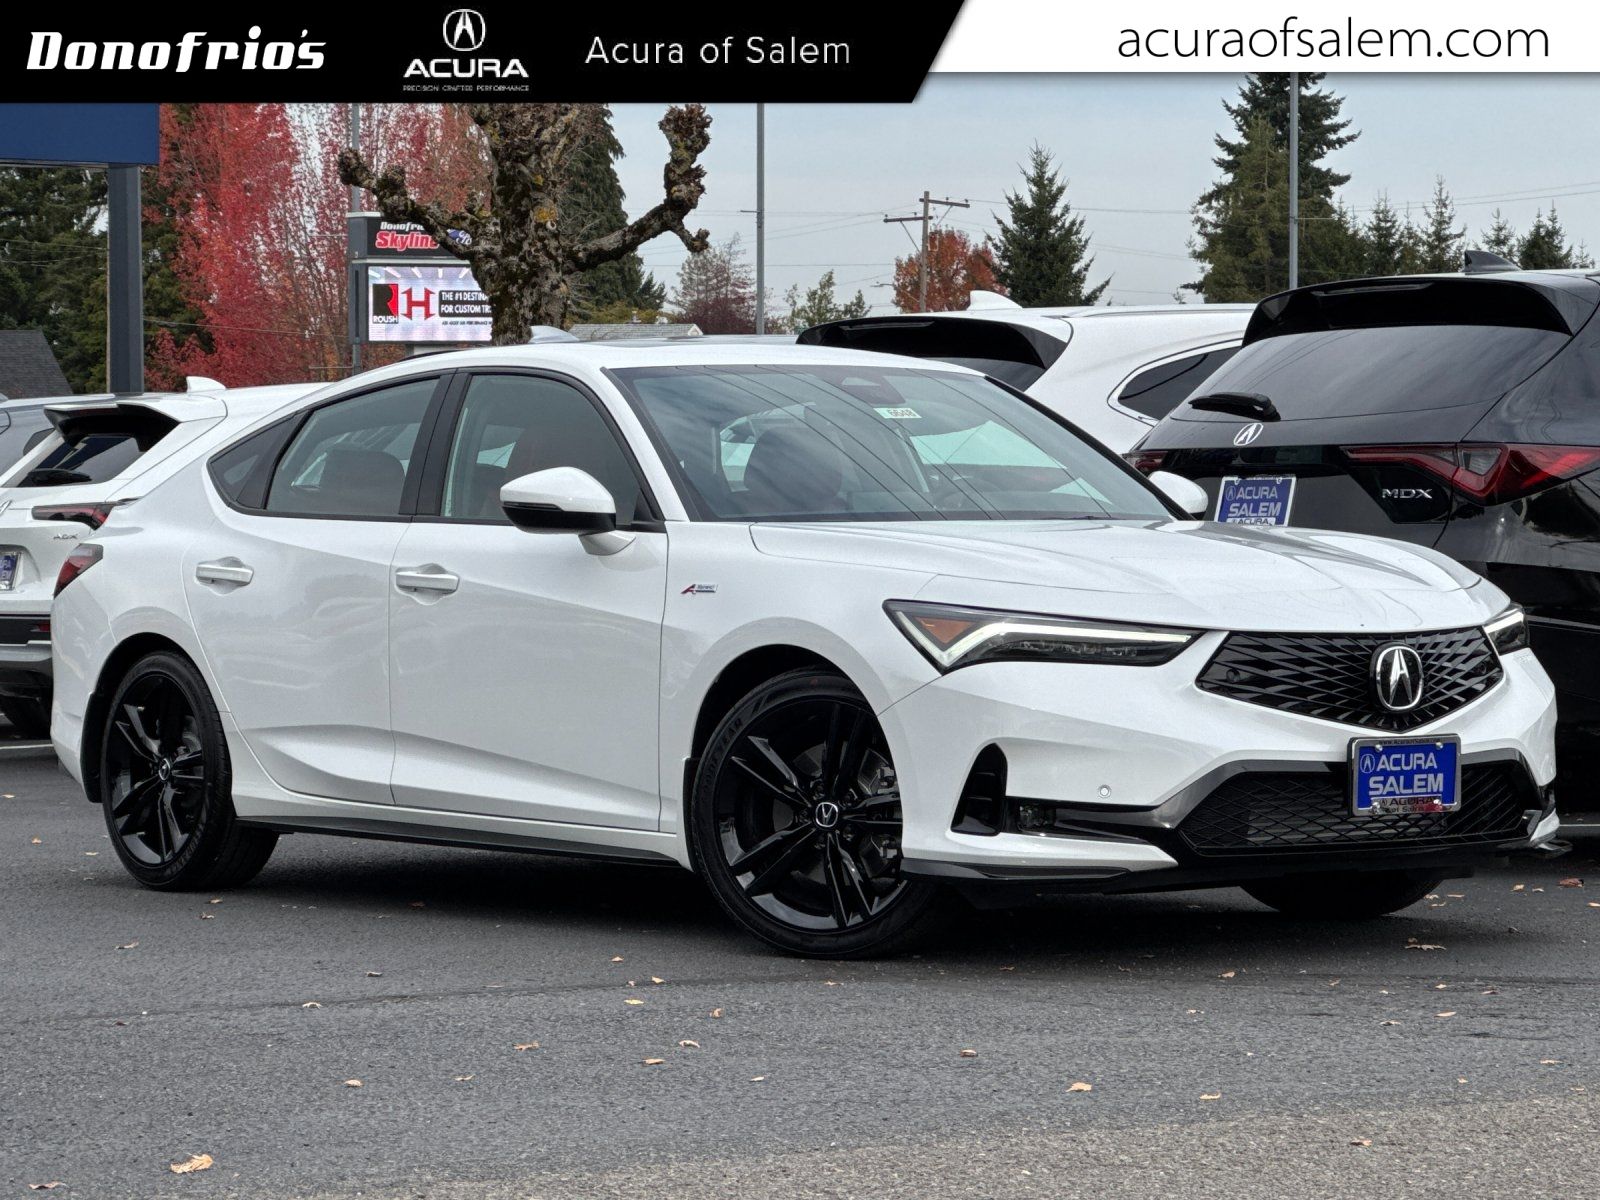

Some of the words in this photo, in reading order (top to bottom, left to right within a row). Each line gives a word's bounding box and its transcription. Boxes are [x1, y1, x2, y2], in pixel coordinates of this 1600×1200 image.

[441, 291, 454, 301] THE
[455, 291, 463, 301] #1
[440, 304, 454, 313] FOR
[454, 304, 481, 314] CUSTOM
[372, 315, 399, 323] ROUSH
[1235, 485, 1279, 500] ACURA
[1381, 488, 1433, 499] MDX
[1227, 501, 1282, 518] SALEM
[1376, 752, 1438, 772] ACURA
[1368, 773, 1444, 796] SALEM
